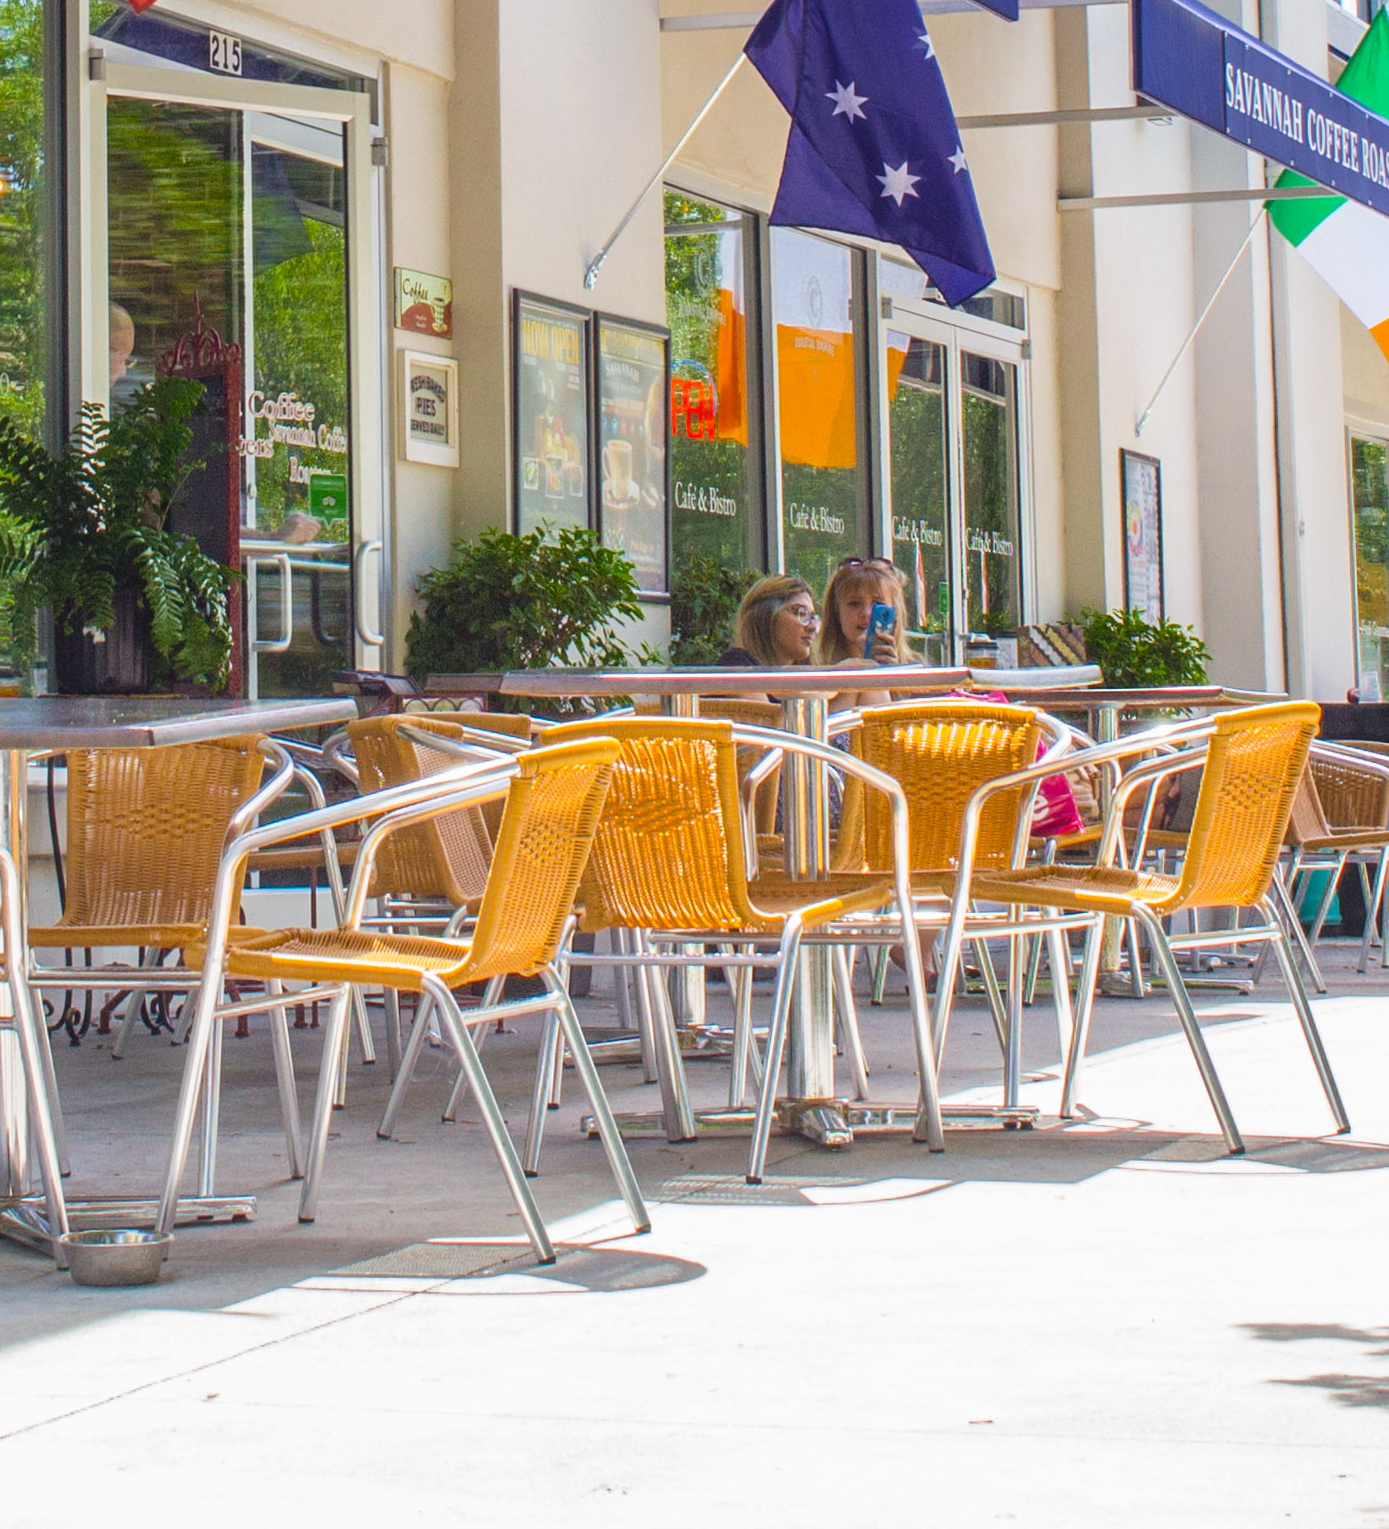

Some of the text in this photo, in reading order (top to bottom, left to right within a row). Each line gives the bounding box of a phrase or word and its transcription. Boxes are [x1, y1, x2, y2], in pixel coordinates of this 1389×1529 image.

[212, 34, 240, 72] 215
[1225, 62, 1304, 144] SAVANNAH
[1307, 108, 1360, 174] COFFEE
[402, 278, 428, 304] Coffee
[552, 324, 580, 365] OPEN
[248, 390, 316, 421] Coffee
[415, 397, 436, 417] PIES
[671, 377, 715, 441] PEN
[697, 487, 708, 512] &
[709, 486, 737, 516] Bistro
[811, 507, 820, 531] &
[820, 506, 845, 534] Bistro
[911, 520, 919, 543] &
[920, 519, 941, 546] Bistro
[992, 530, 1012, 556] Bistro
